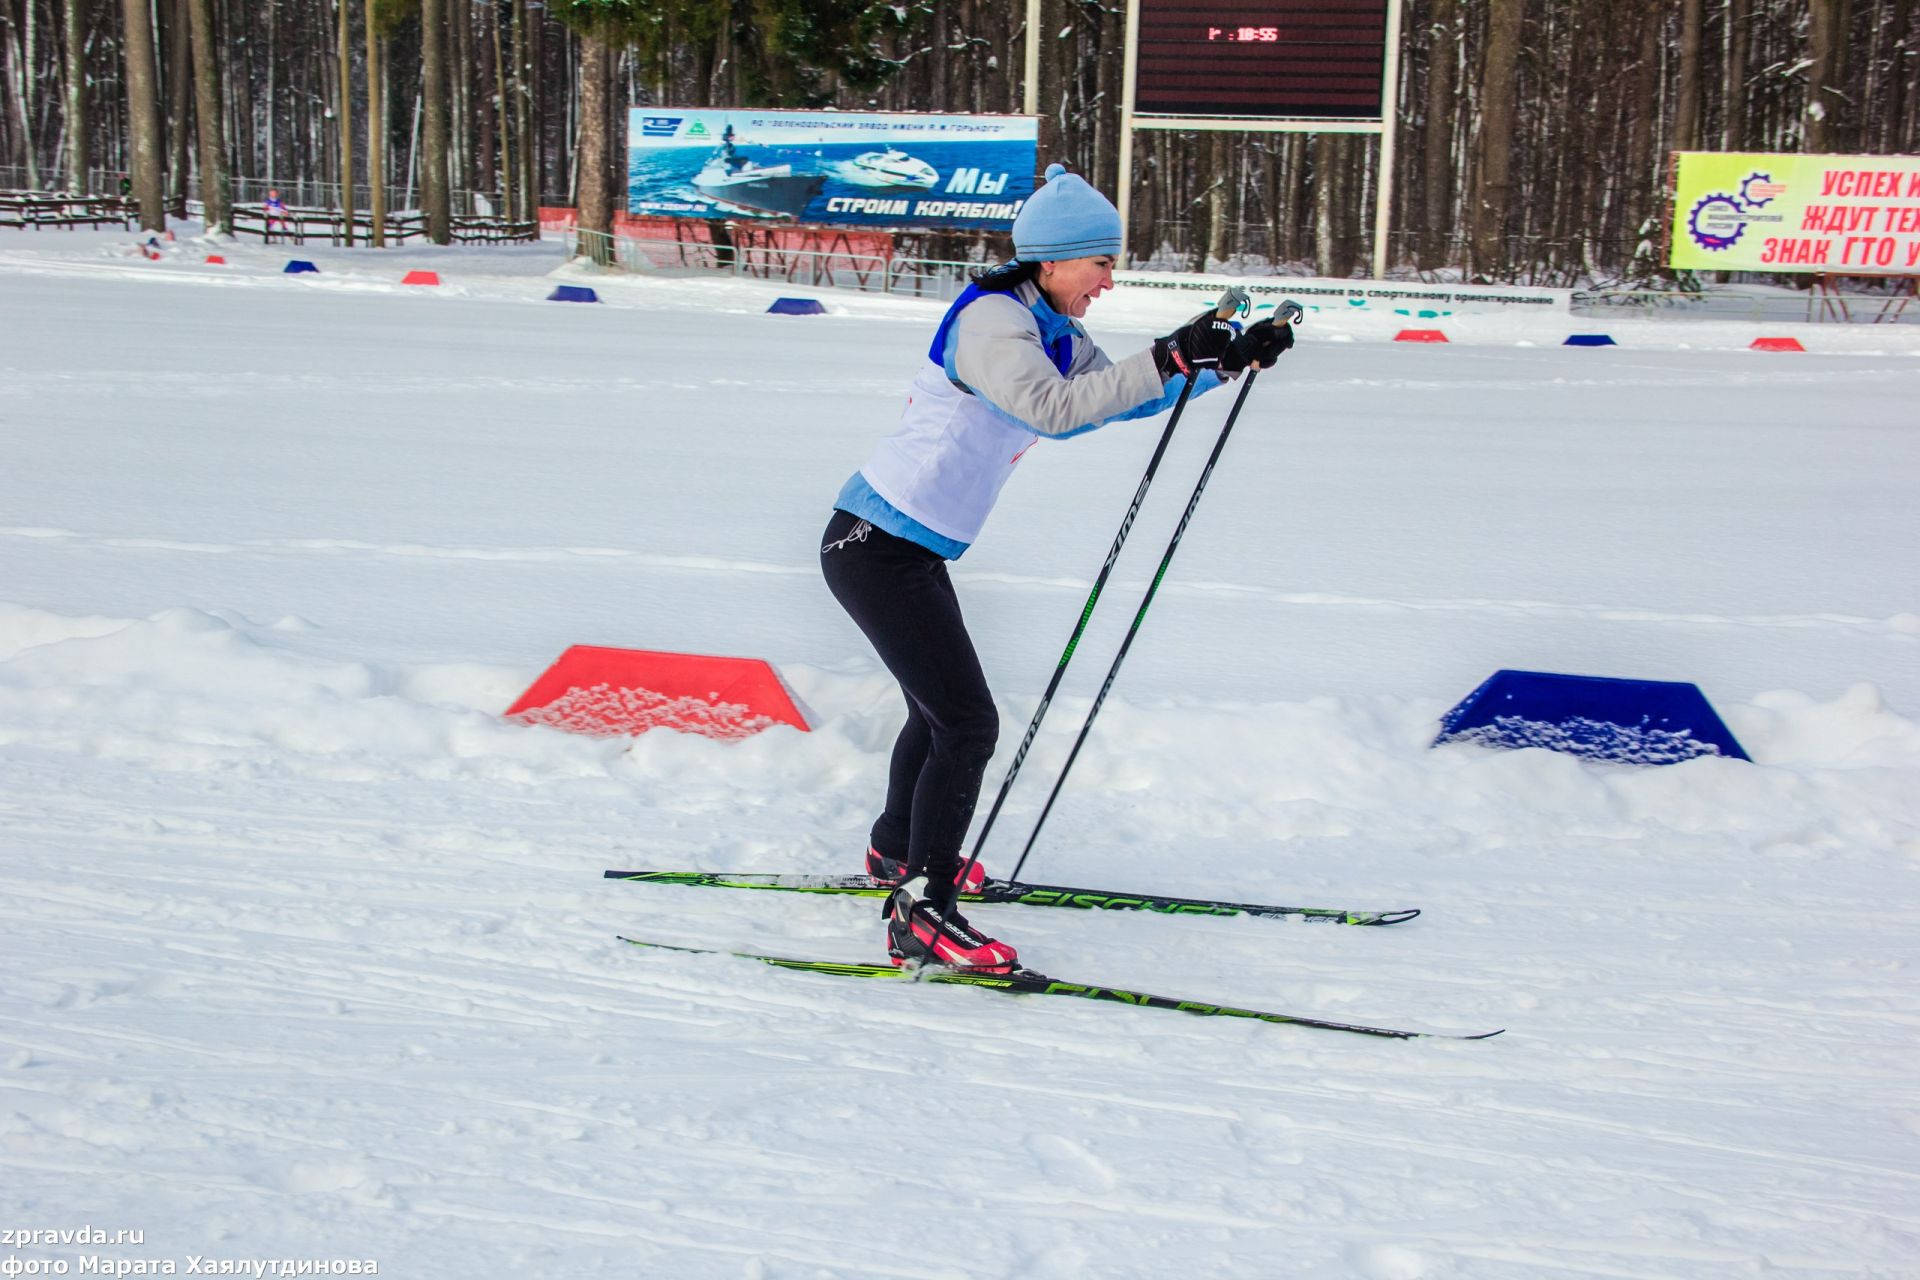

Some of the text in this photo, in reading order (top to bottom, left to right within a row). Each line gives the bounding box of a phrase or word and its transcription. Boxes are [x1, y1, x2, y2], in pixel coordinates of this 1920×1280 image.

[1820, 170, 1904, 198] УСПЕХ
[826, 197, 1024, 219] СТРОИМ КОРАБЛИ!
[1801, 205, 1880, 235] ЖДУТ
[1761, 238, 1831, 265] ЗНАК
[1841, 236, 1896, 267] ГТО
[1250, 284, 1345, 297] соревнования
[1348, 288, 1365, 298] по
[1367, 288, 1452, 303] спортивному
[1454, 292, 1554, 306] ориентированию
